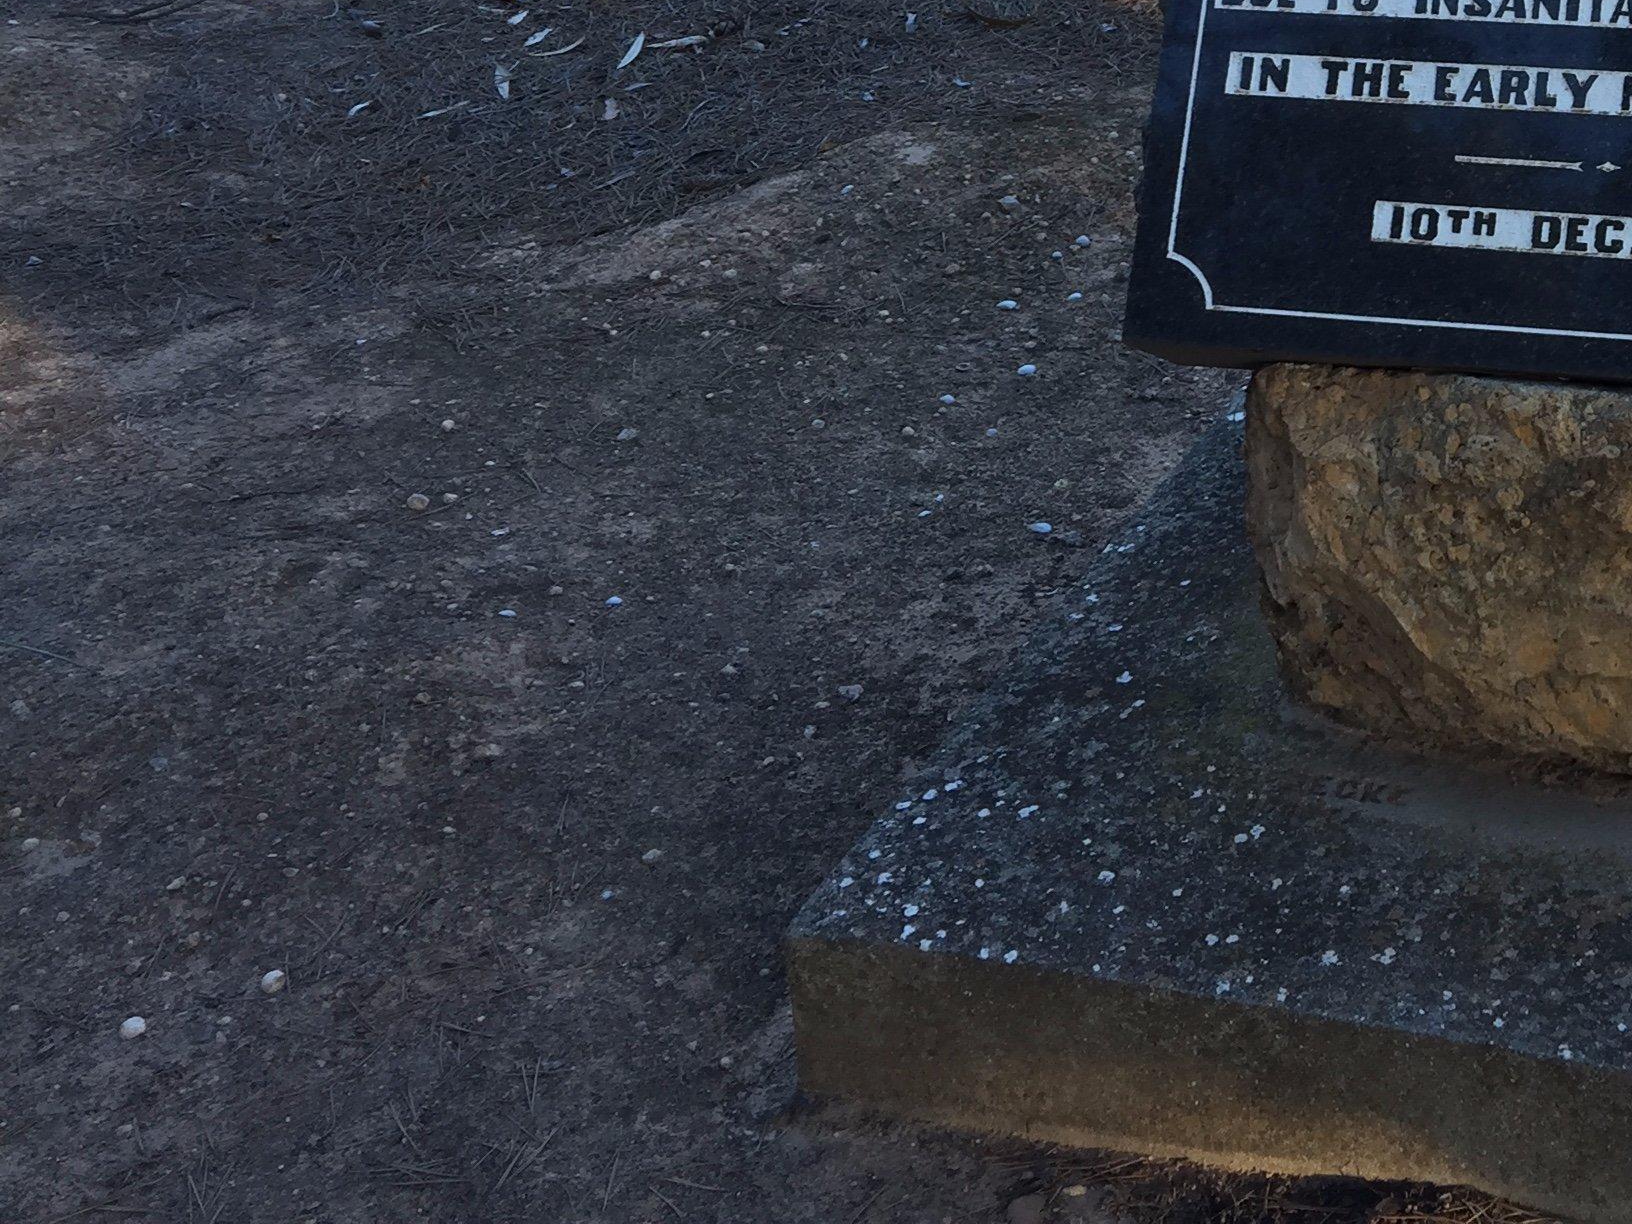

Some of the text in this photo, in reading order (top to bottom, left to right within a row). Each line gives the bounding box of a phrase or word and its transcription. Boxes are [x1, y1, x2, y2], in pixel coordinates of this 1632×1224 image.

[1240, 54, 1290, 94] IN
[1322, 58, 1411, 99] THE
[1433, 63, 1598, 111] EARLY
[1389, 204, 1497, 241] 10TH
